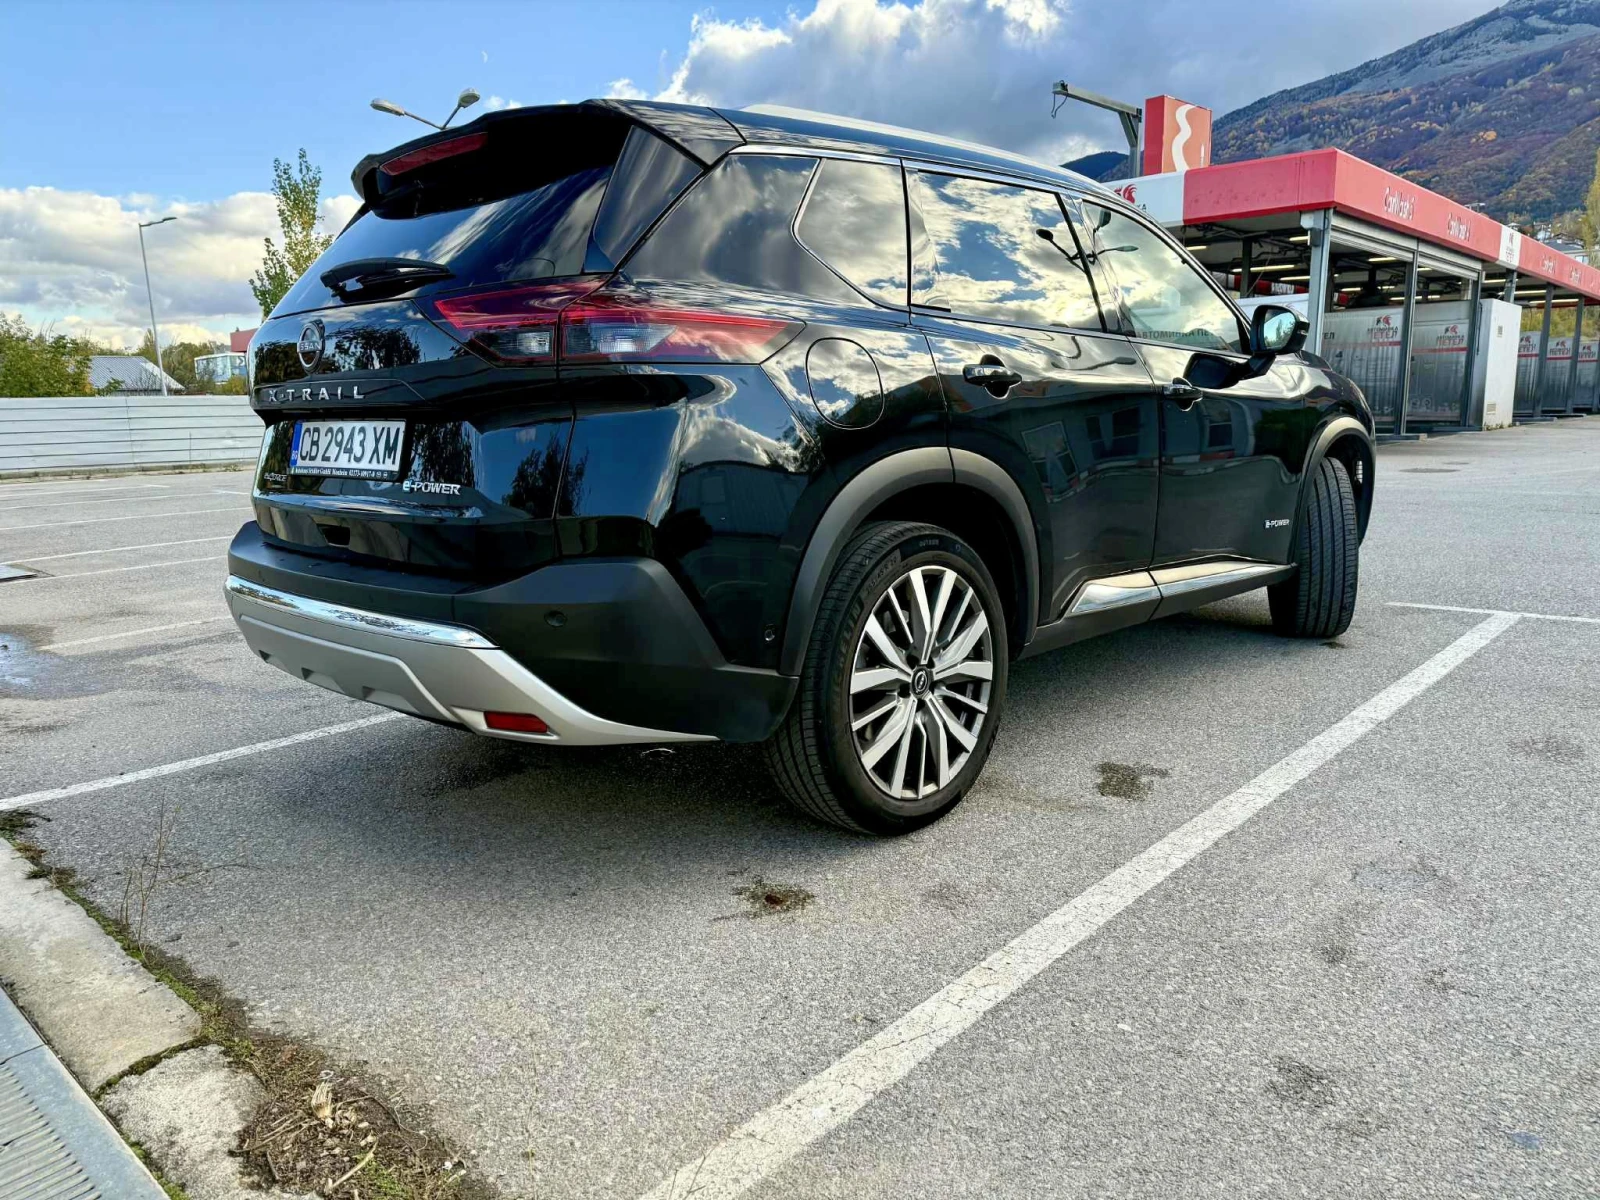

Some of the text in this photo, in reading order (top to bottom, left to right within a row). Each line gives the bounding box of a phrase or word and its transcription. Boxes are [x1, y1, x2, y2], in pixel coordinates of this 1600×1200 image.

[268, 386, 365, 402] X-TRAIL
[321, 427, 367, 463] 2943
[369, 426, 400, 465] XM
